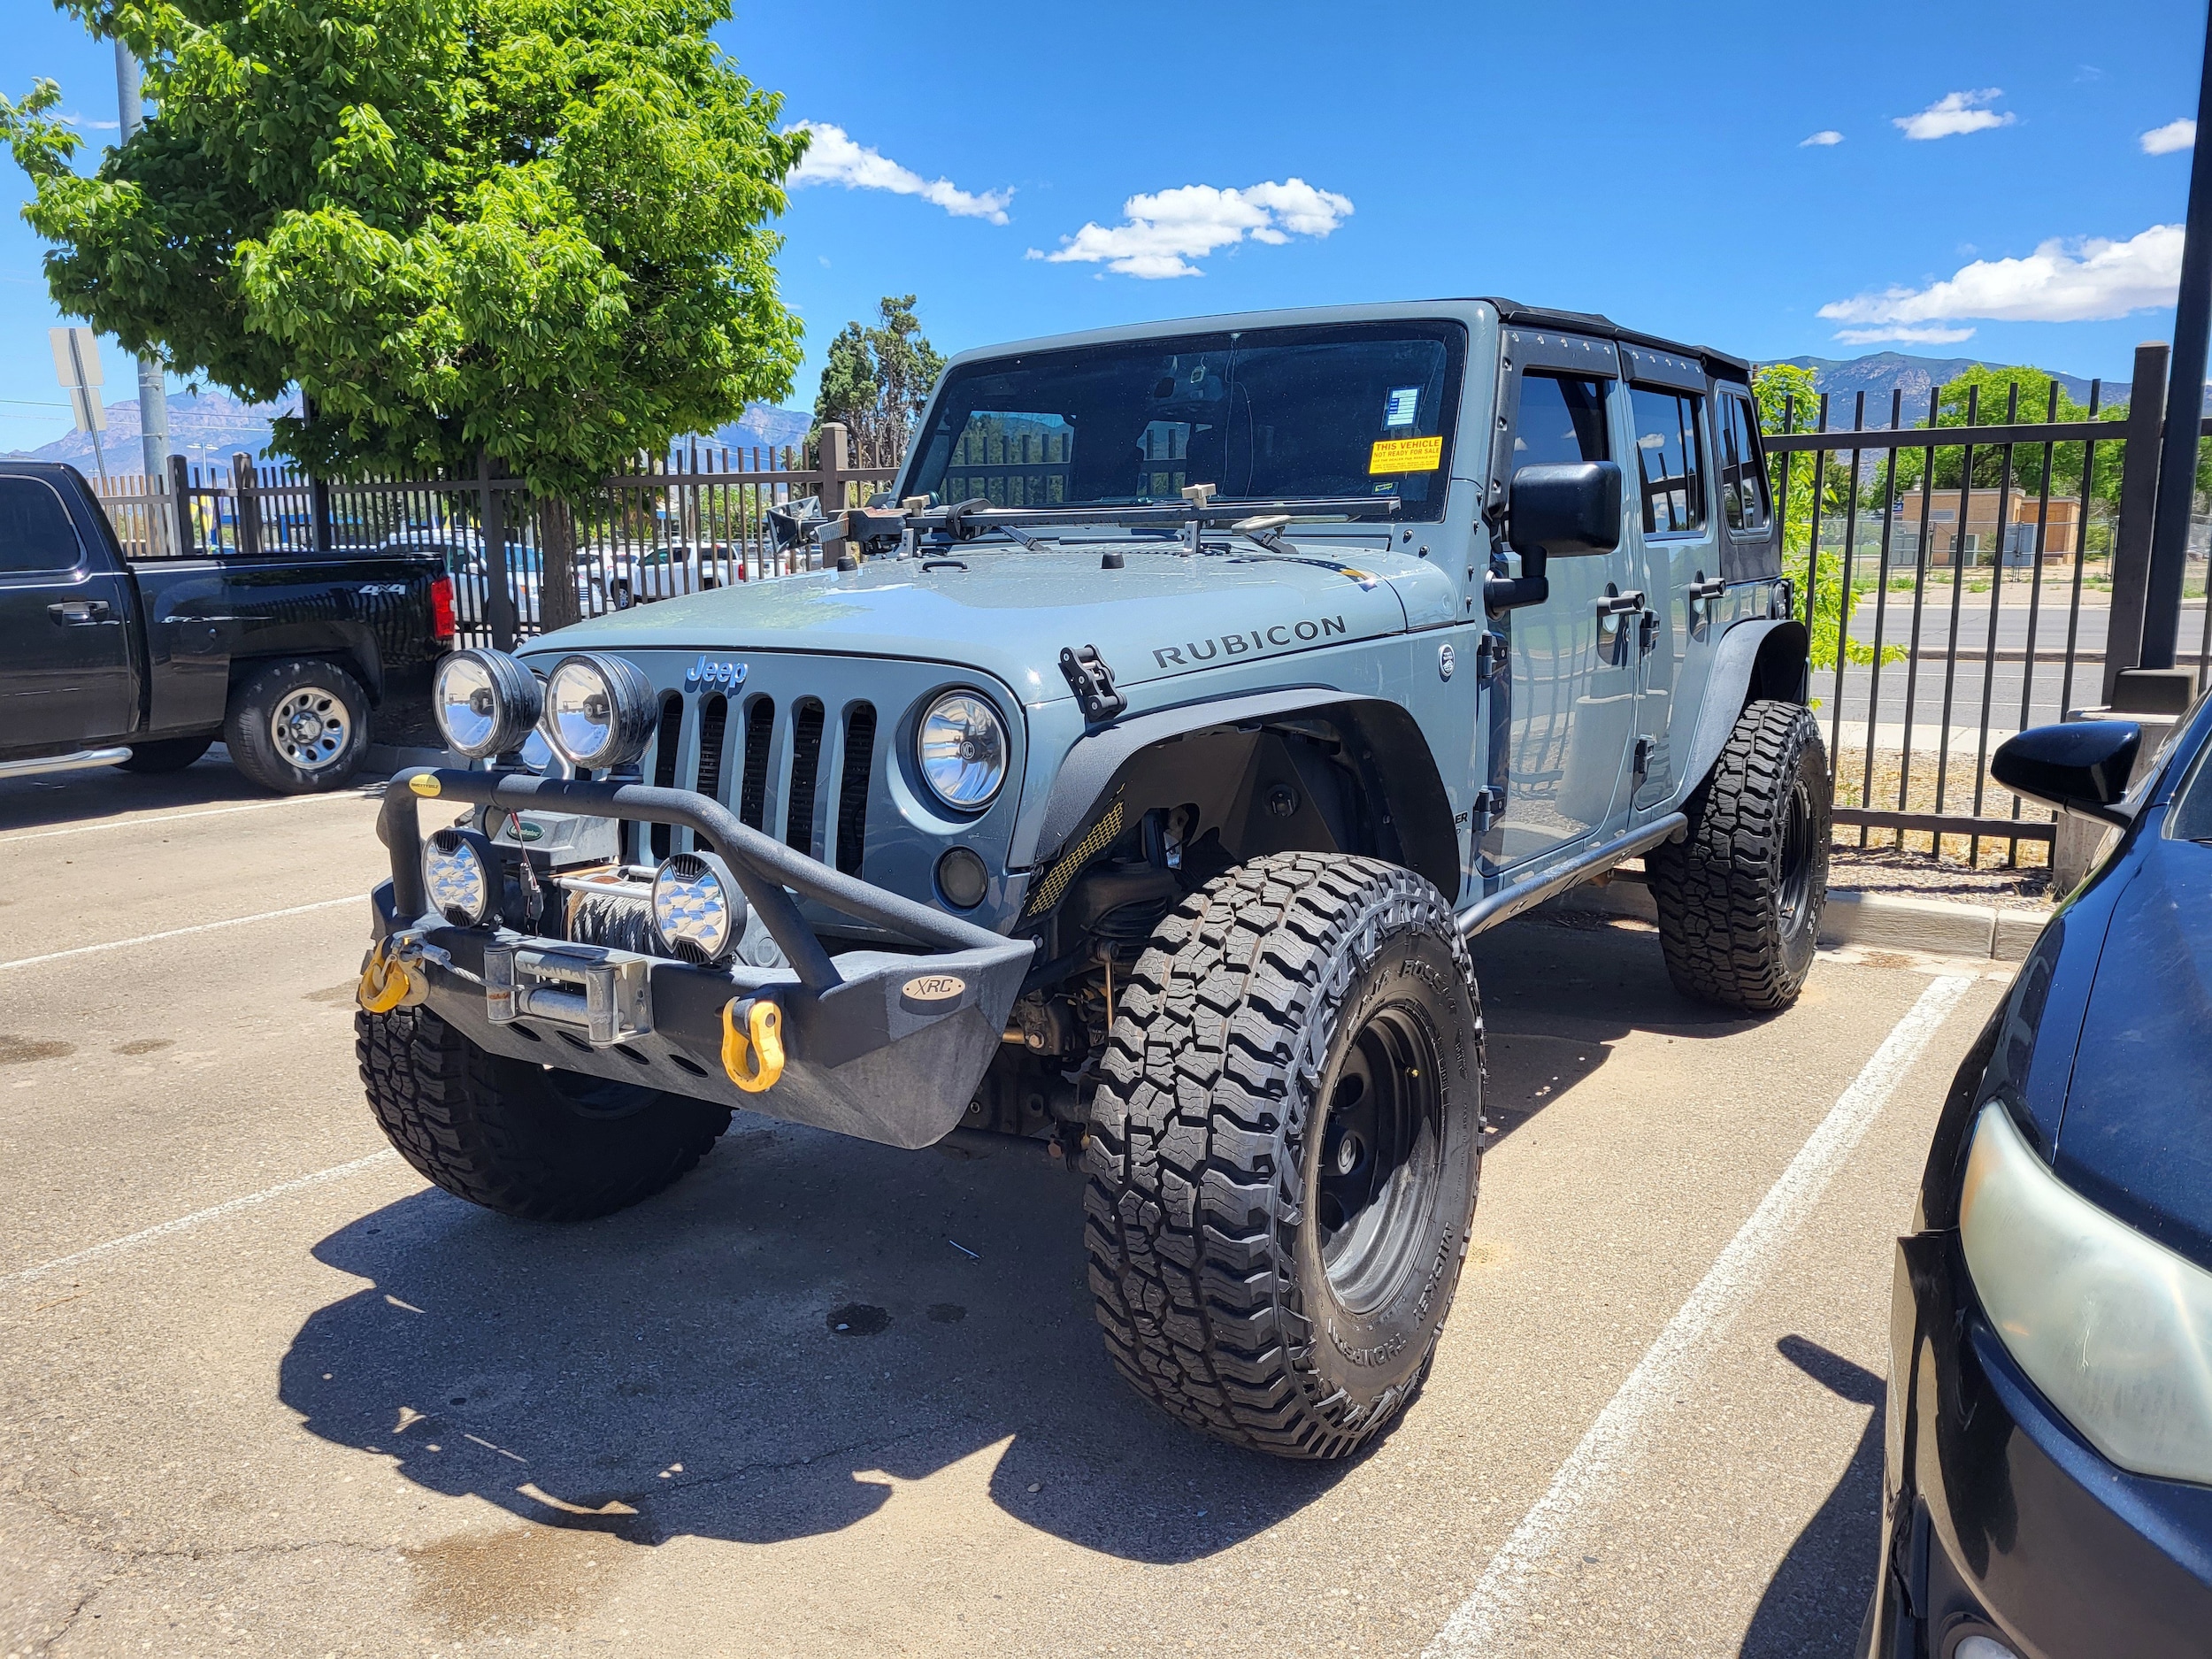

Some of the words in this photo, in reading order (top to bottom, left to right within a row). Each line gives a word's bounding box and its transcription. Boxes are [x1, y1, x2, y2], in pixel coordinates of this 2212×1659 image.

[1401, 439, 1440, 449] VEHICLE
[1151, 614, 1348, 669] RUBICON
[686, 655, 749, 688] Jeep
[963, 743, 972, 757] KC
[914, 979, 954, 996] XRC
